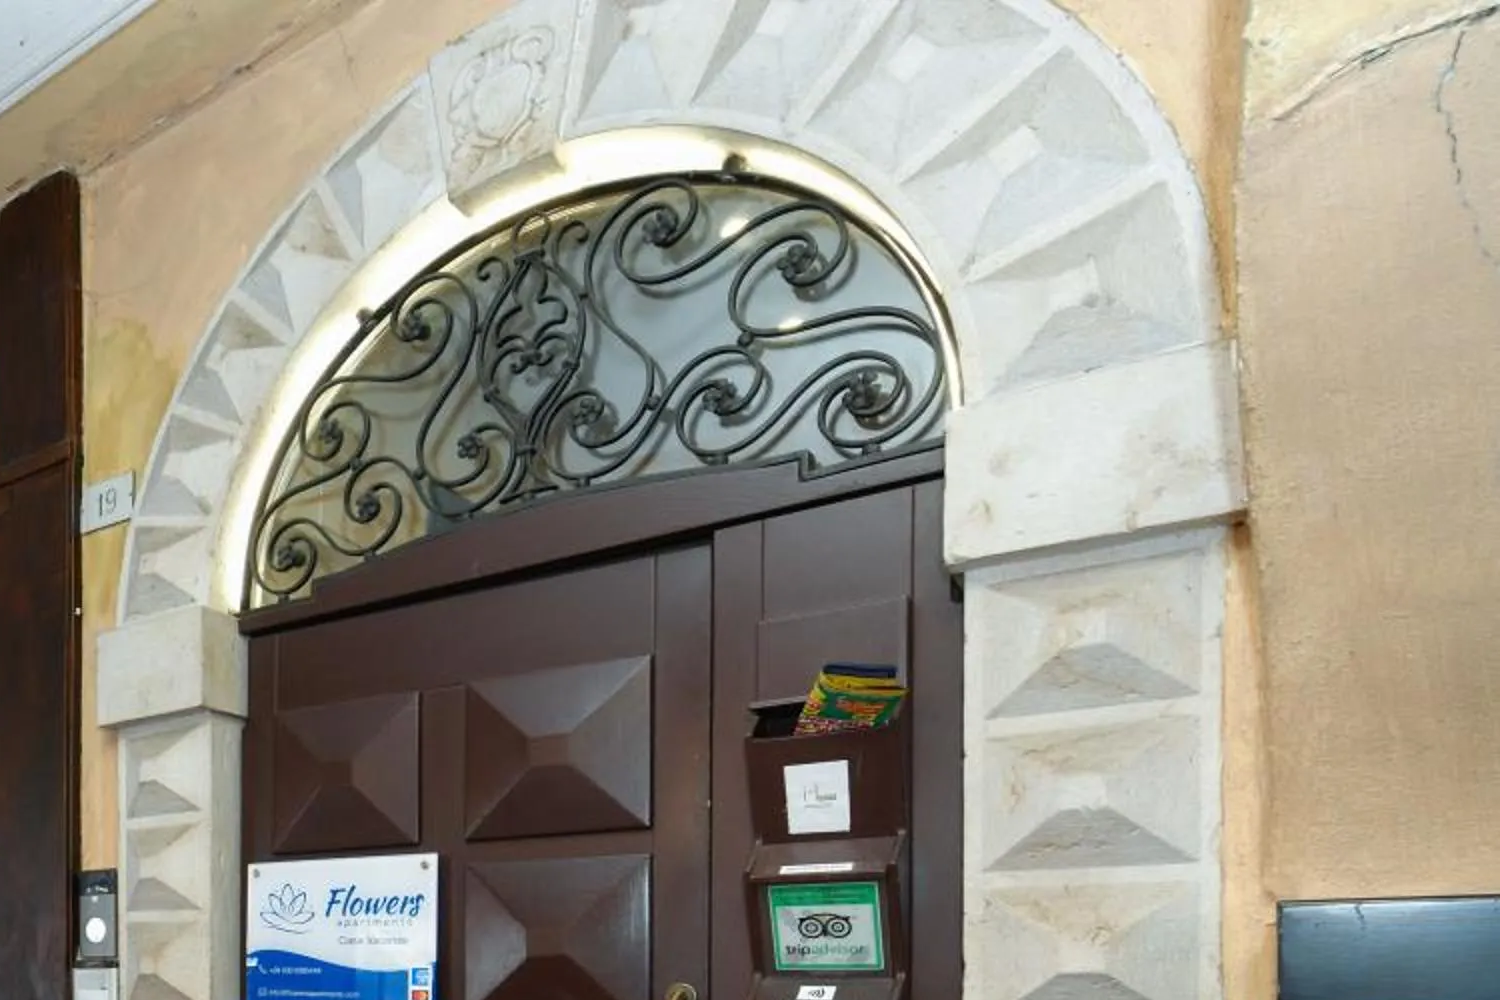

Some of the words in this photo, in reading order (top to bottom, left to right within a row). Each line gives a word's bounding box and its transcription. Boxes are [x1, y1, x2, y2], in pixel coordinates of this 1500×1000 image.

[98, 487, 117, 517] 19
[325, 884, 426, 918] Flowers
[336, 918, 413, 929] apartments
